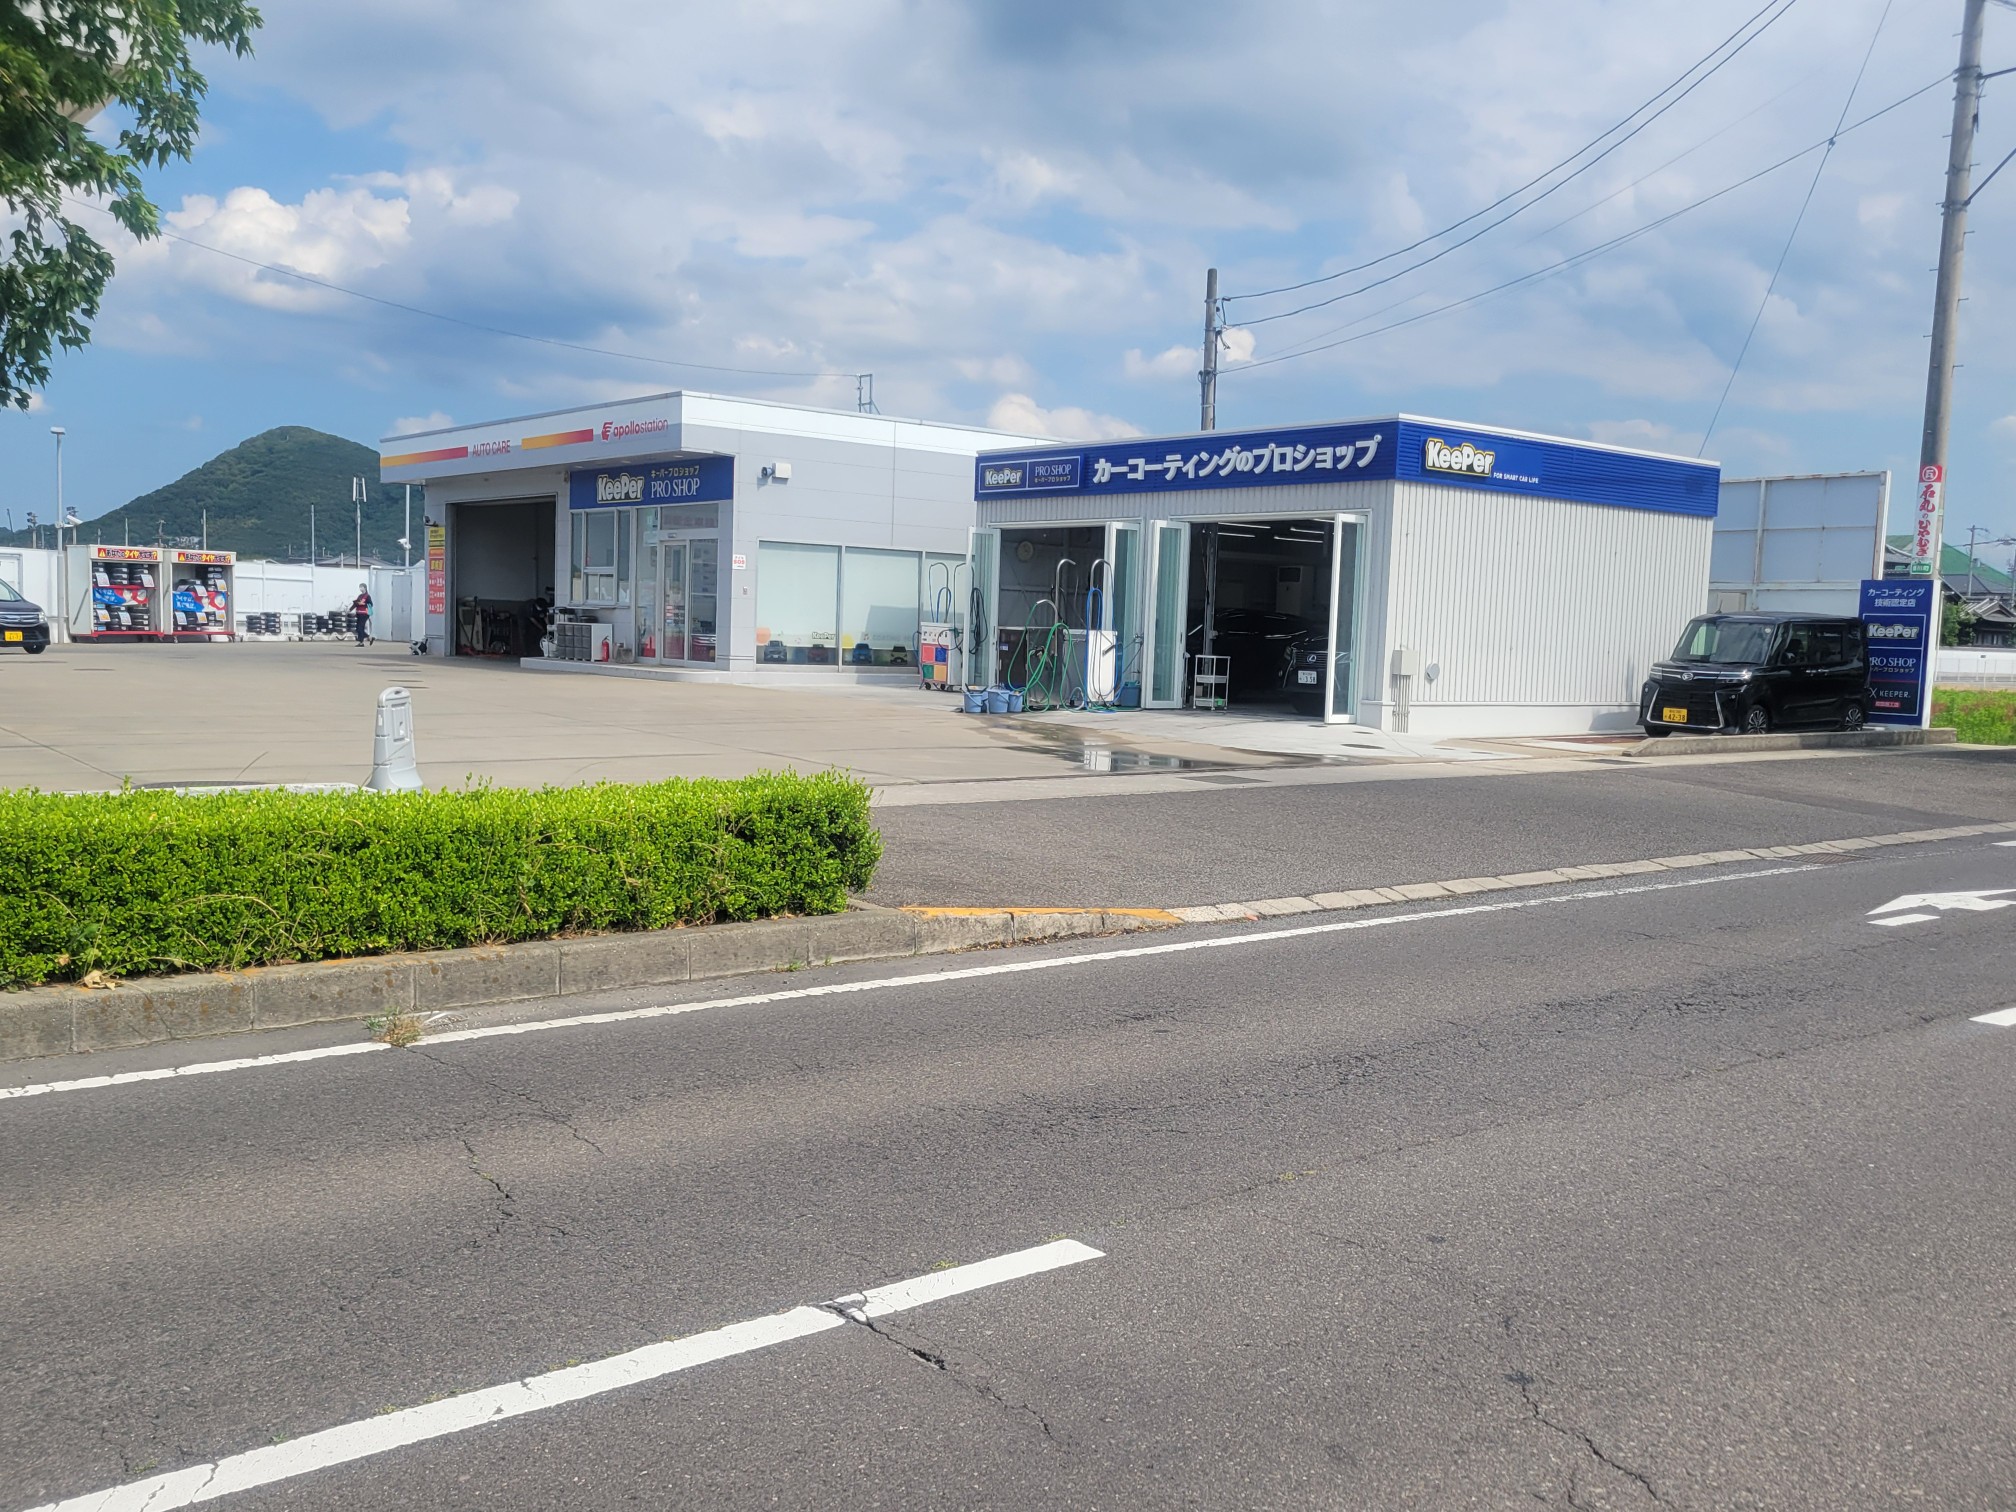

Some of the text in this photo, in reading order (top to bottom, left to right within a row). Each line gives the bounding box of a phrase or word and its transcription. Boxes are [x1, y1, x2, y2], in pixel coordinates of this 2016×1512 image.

[613, 417, 669, 440] apollostation
[473, 440, 511, 457] AUTO CARE
[1426, 438, 1495, 476] KeePer
[1092, 434, 1383, 484] カーコーティングのプロショップ
[985, 468, 1023, 486] KeePer
[1035, 464, 1072, 476] PRO SHOP
[597, 473, 644, 503] KeePer
[651, 478, 700, 498] PRO SHOP
[1867, 588, 1926, 597] カーコーティング
[1868, 624, 1920, 639] KeePer
[1887, 658, 1917, 668] SHOP
